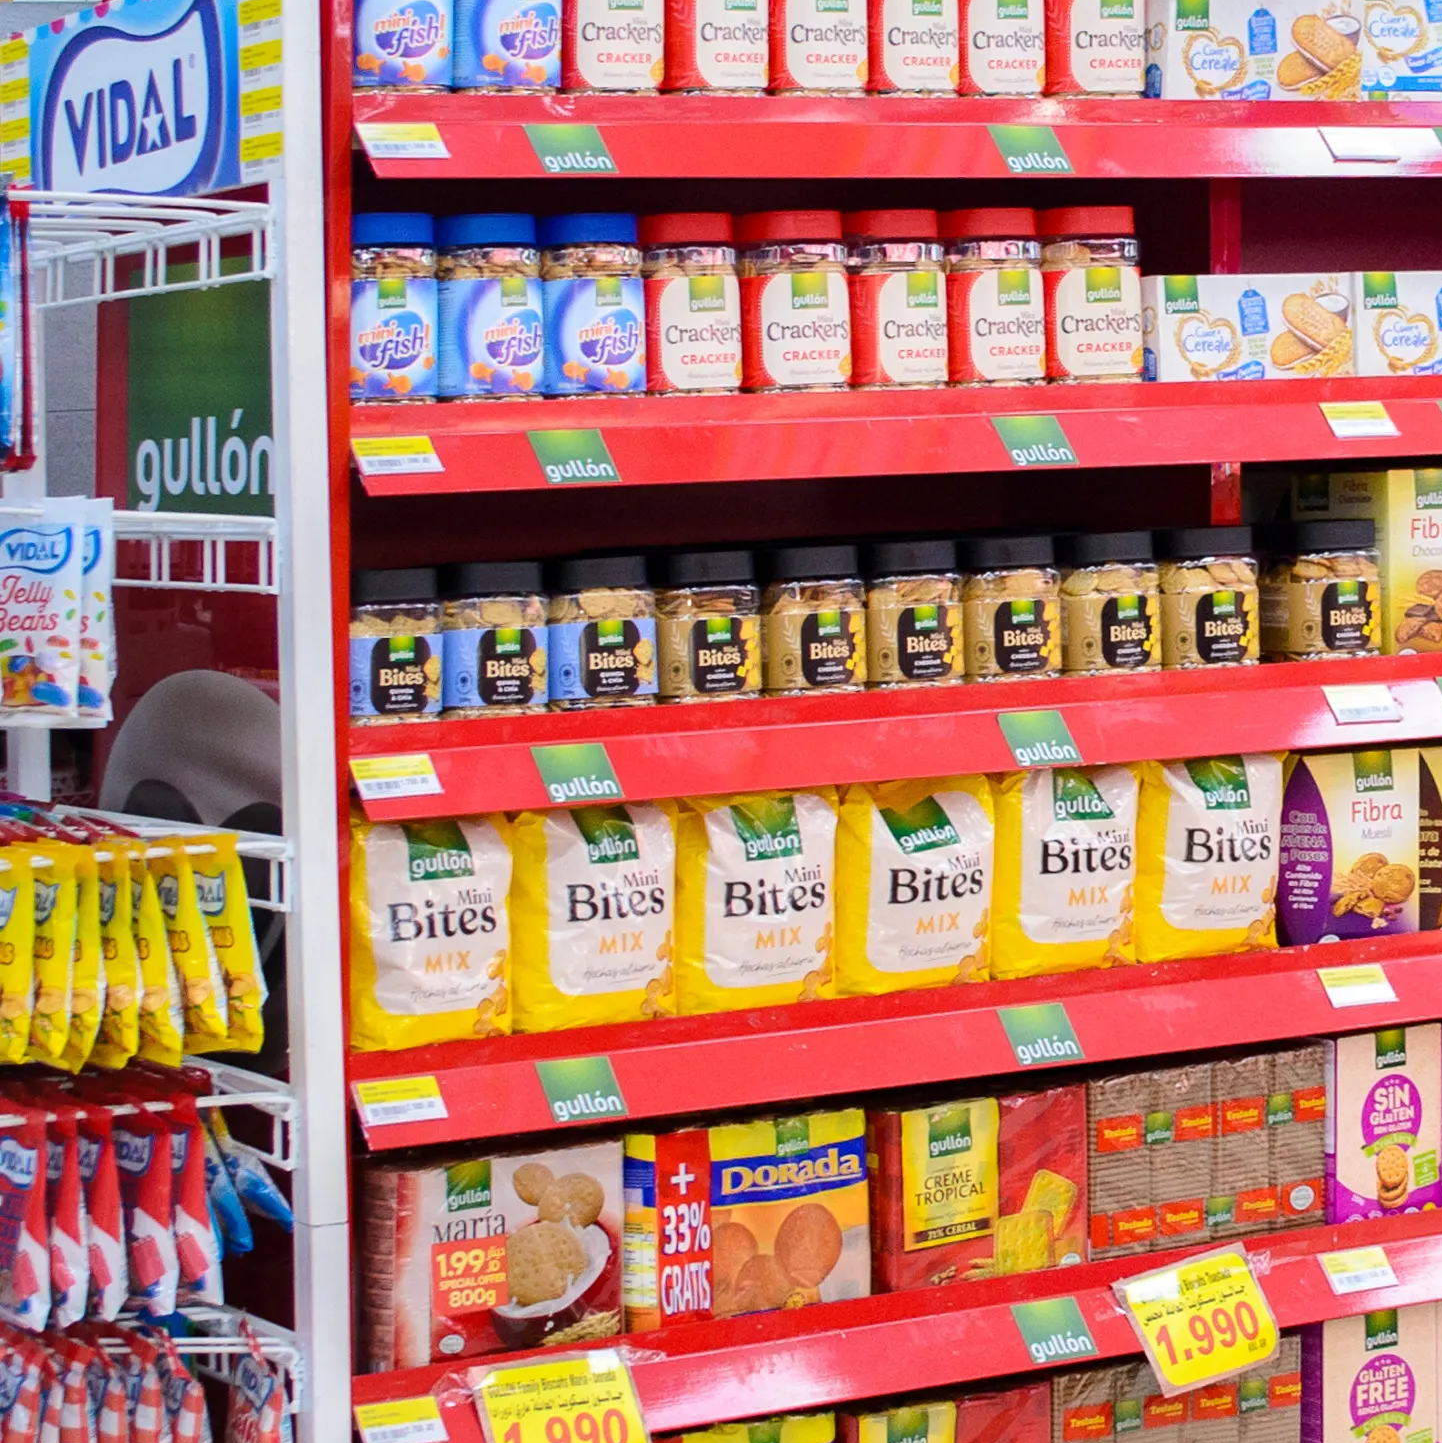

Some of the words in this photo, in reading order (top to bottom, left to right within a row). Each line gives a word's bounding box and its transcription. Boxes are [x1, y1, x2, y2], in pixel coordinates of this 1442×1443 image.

[374, 9, 413, 33] mini
[581, 22, 662, 45] Crackers
[701, 21, 768, 46] Crackers
[888, 25, 959, 49] Crackers
[973, 30, 1044, 52] Crackers
[597, 52, 652, 64] CRACKER
[65, 57, 197, 176] VIDAL
[544, 152, 613, 172] gullón
[1007, 152, 1069, 172] gullón
[357, 319, 396, 344] mini
[484, 318, 519, 342] mini
[665, 323, 742, 345] Crackers
[1061, 314, 1142, 335] Crackers
[681, 352, 736, 365] CRACKER
[1077, 342, 1133, 353] CRACKER
[135, 409, 275, 512] gullón
[1012, 443, 1073, 466] gullón
[545, 460, 614, 483] gullón
[6, 541, 59, 561] VIDAL
[906, 635, 947, 654] Bites
[379, 669, 424, 688] Bites
[549, 775, 618, 802] gullón
[1355, 774, 1393, 791] gullón
[1351, 800, 1403, 824] Fibra
[1039, 837, 1132, 876] Bites
[1184, 826, 1272, 864] Bites
[622, 869, 660, 887] Mini
[784, 863, 822, 884] Mini
[1211, 875, 1252, 895] MIX
[456, 888, 492, 906] Mini
[724, 877, 826, 918] Bites
[887, 866, 984, 906] Bites
[566, 880, 666, 923] Bites
[387, 899, 497, 943] Bites
[916, 913, 961, 935] MIX
[599, 931, 644, 954] MIX
[424, 950, 471, 974] MIX
[1016, 1034, 1079, 1063] gullón
[554, 1090, 622, 1118] gullón
[929, 1130, 972, 1156] gullón
[721, 1149, 861, 1195] Dorada
[924, 1169, 973, 1190] CREME
[448, 1186, 491, 1211] gullón
[914, 1182, 986, 1207] TROPICAL
[432, 1208, 505, 1242] María
[662, 1200, 711, 1256] 33%
[436, 1249, 485, 1277] 1.99
[449, 1288, 496, 1307] 800g
[660, 1261, 712, 1317] GRATIS
[1156, 1300, 1260, 1366] 1.990
[1029, 1329, 1093, 1362] gullón
